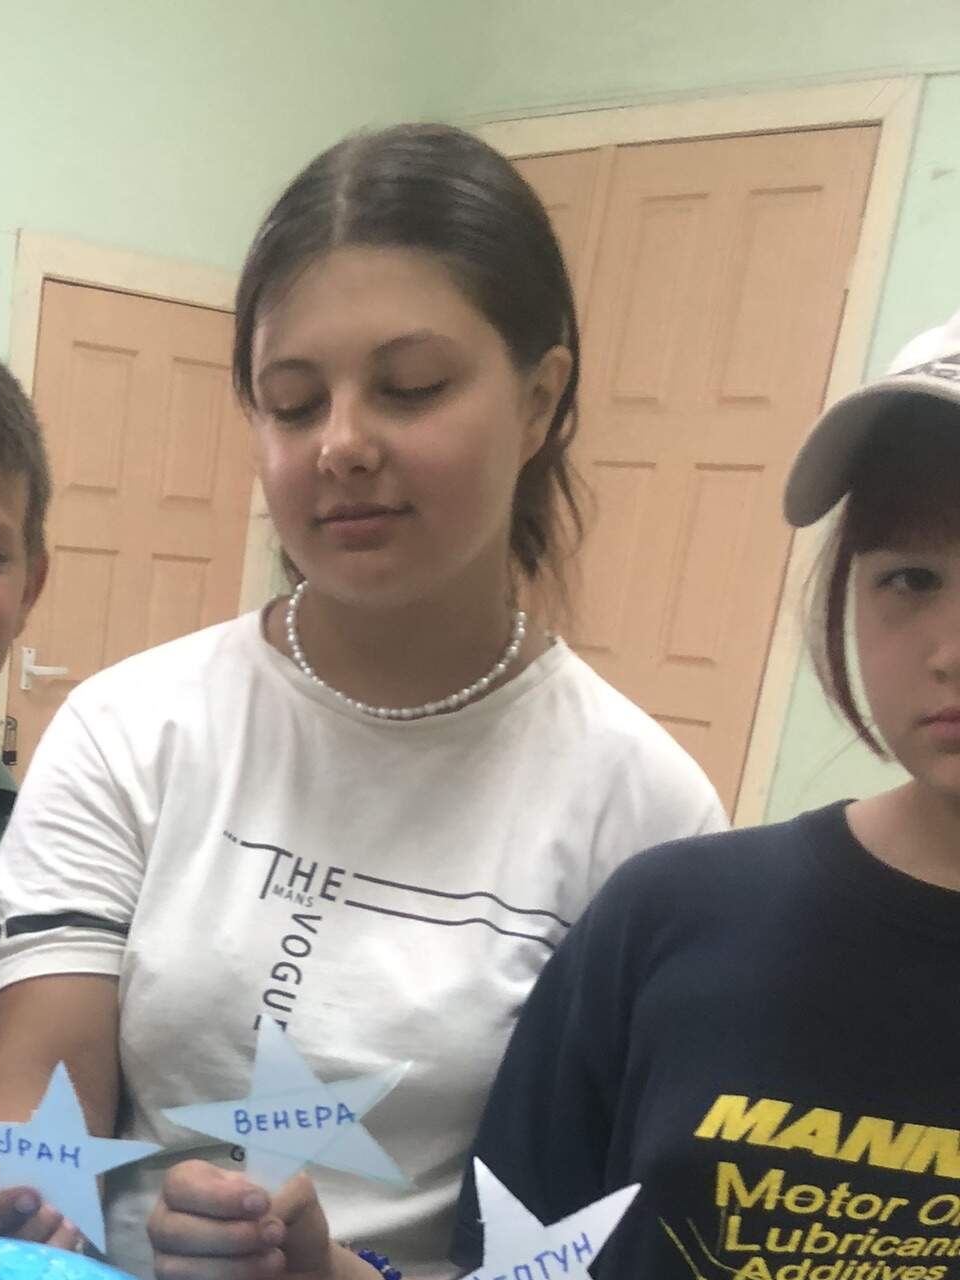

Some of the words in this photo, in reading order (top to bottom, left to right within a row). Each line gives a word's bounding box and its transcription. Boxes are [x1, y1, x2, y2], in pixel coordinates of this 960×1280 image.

[241, 840, 346, 901] THE
[272, 884, 314, 908] MANS
[234, 1102, 357, 1135] ВЕНЕРА
[715, 1161, 909, 1222] Motor
[918, 1194, 960, 1226] O
